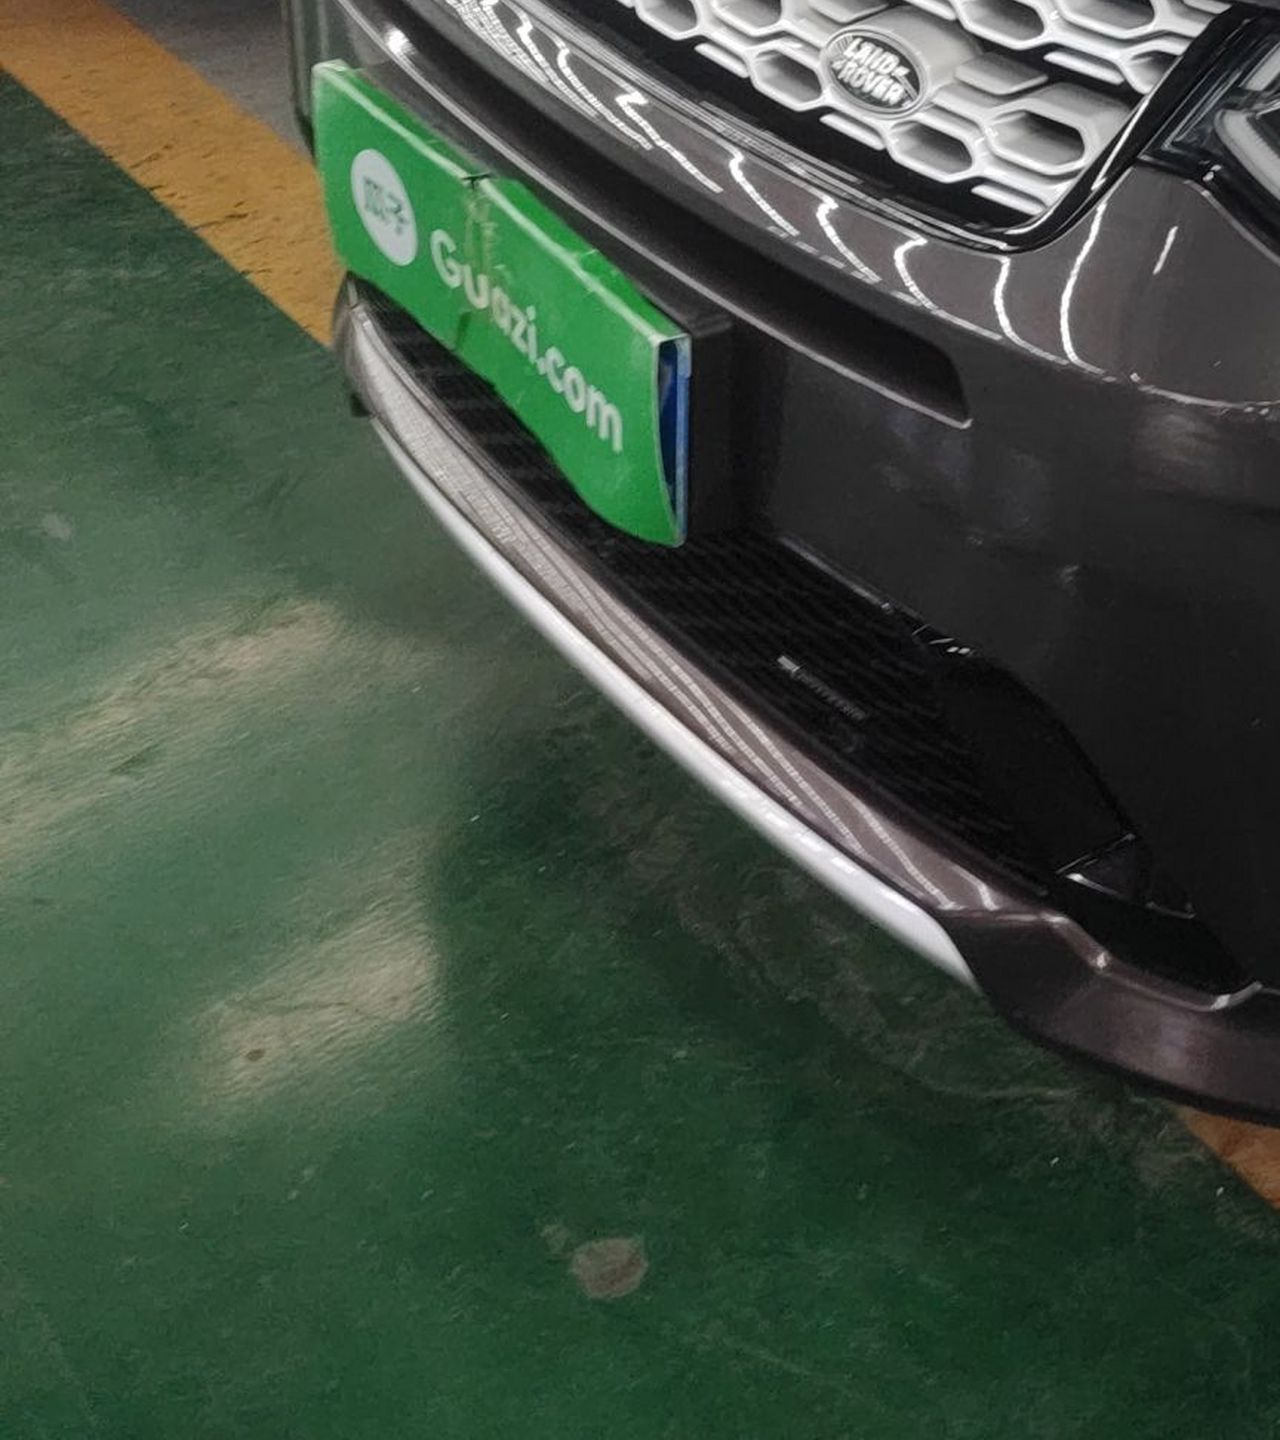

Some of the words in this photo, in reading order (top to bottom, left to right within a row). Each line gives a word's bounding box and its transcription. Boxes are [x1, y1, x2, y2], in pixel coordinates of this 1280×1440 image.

[844, 37, 900, 75] LAND
[838, 60, 904, 105] ROVER
[430, 228, 624, 455] Guazi.com
